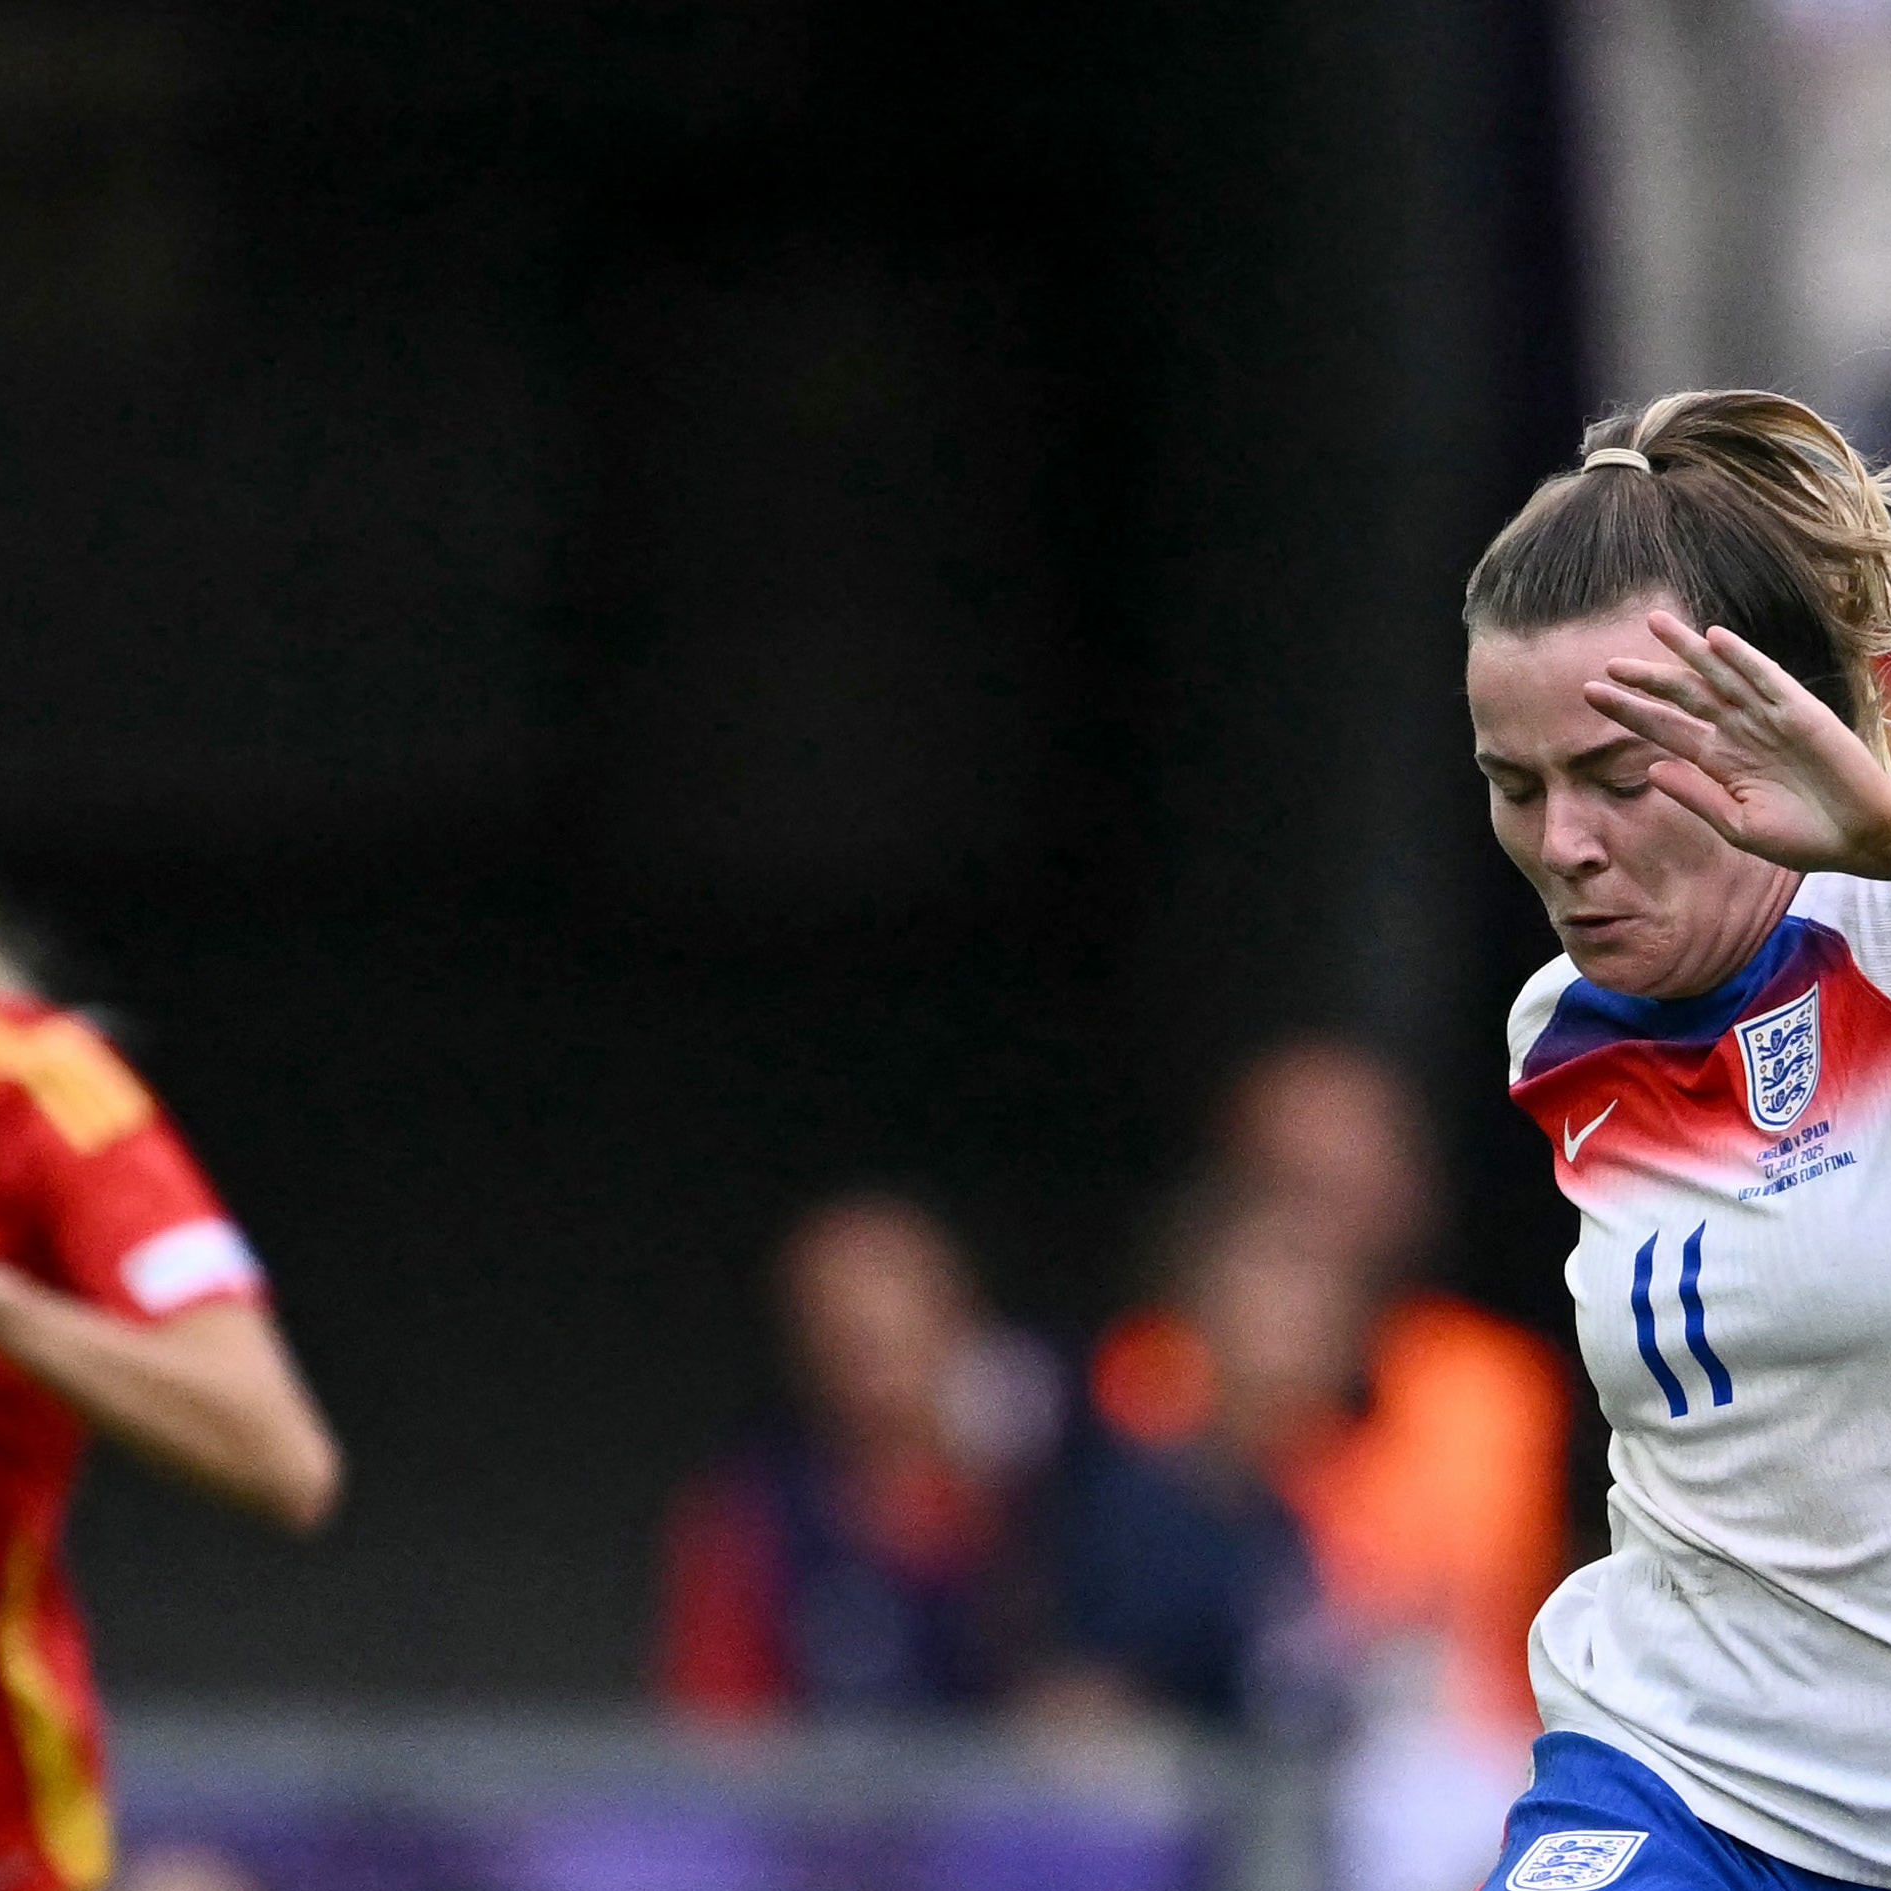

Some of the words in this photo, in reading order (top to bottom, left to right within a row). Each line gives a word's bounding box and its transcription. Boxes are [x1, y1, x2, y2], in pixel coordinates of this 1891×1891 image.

[1801, 1120, 1830, 1143] SPAIN
[1800, 1142, 1824, 1164] 2025
[1800, 1162, 1824, 1183] EURO
[1824, 1150, 1858, 1173] FINAL
[1631, 1219, 1733, 1419] 11
